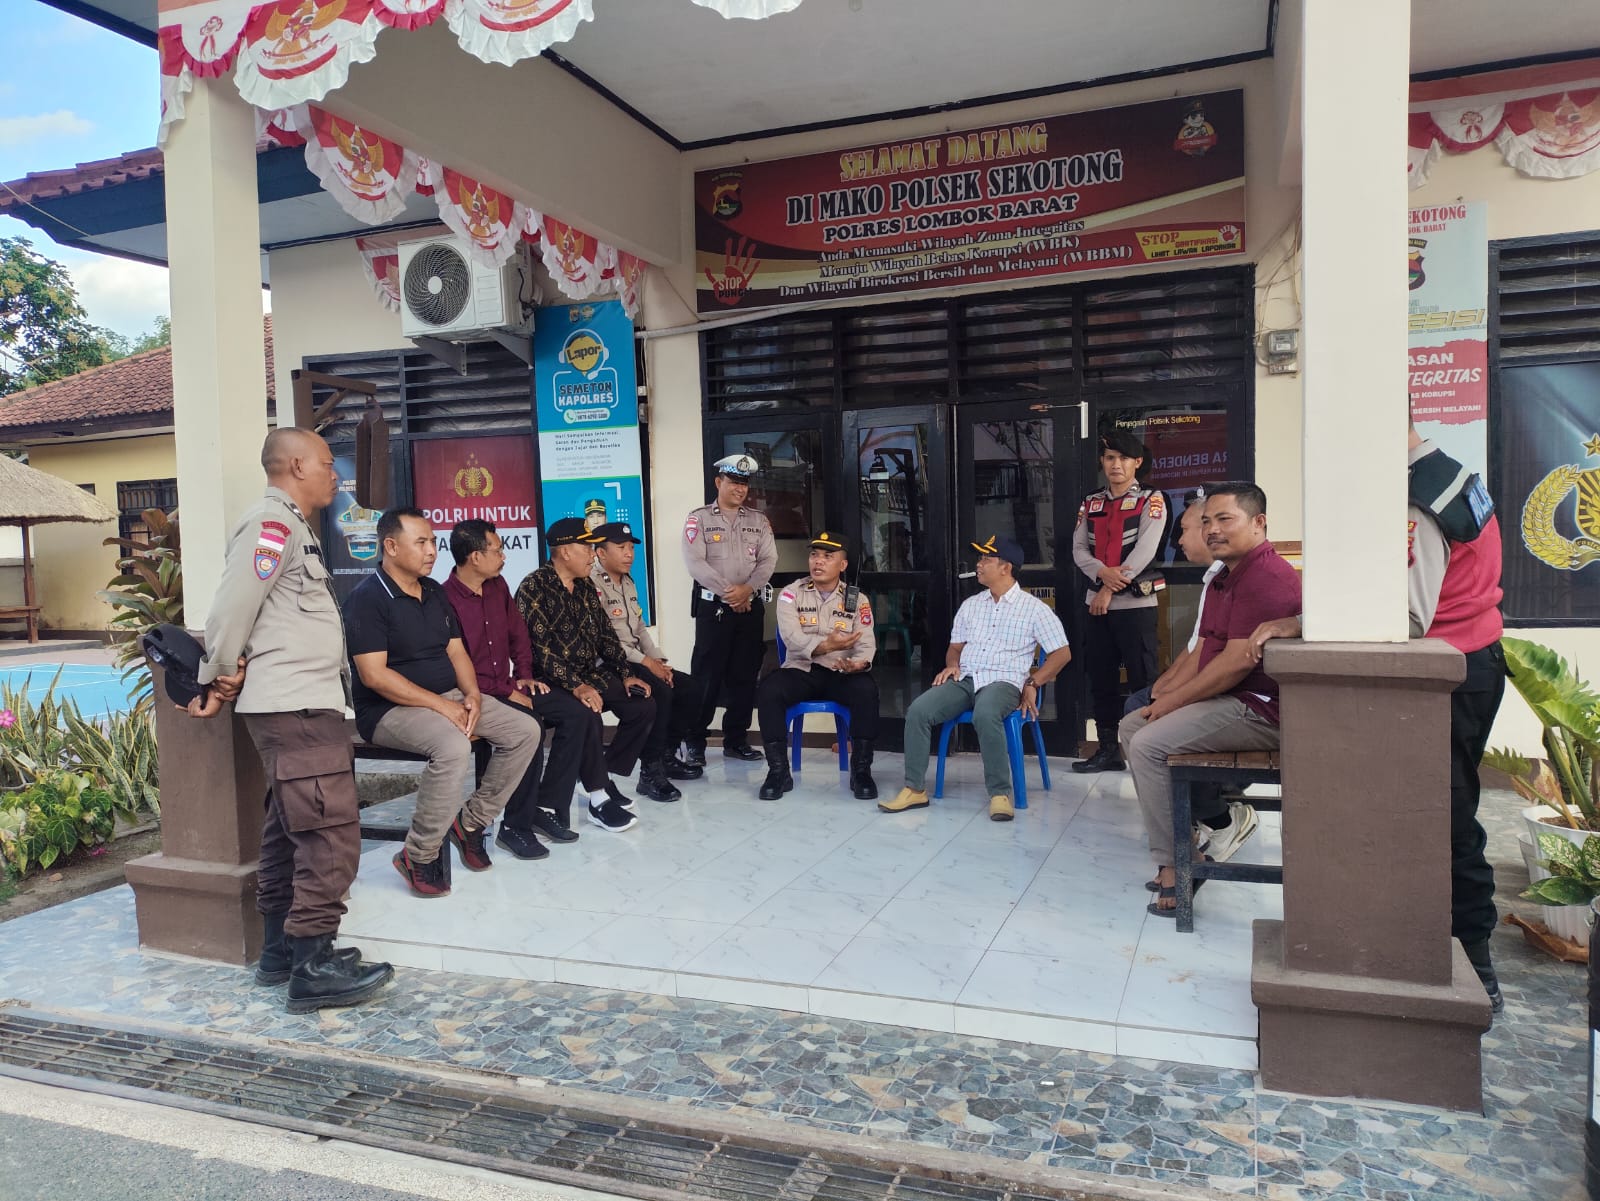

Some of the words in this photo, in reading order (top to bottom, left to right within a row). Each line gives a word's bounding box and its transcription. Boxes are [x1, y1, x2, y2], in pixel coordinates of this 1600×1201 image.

[840, 139, 941, 182] SELAMAT
[946, 122, 1048, 167] DATANG
[786, 194, 814, 226] DI
[818, 184, 885, 222] MAKO
[889, 170, 982, 213] POLSEK
[987, 149, 1123, 199] SEKOTONG
[823, 219, 901, 244] POLRES
[904, 205, 996, 233] LOMBOK
[997, 193, 1079, 221] BARAT
[1408, 205, 1466, 224] KOTONG
[819, 249, 850, 263] Anda
[852, 240, 917, 258] Memasuki
[920, 233, 973, 251] Wilayah
[976, 231, 1011, 244] Zona
[1014, 220, 1084, 239] Integritas
[1142, 231, 1180, 246] STOP
[820, 264, 868, 279] Menuju
[870, 255, 923, 272] Wilayah
[924, 252, 965, 266] Bebas
[968, 243, 1022, 259] Korupsi
[1026, 236, 1079, 254] (WBK)
[718, 276, 743, 290] STOP
[779, 286, 804, 297] Dan
[807, 278, 856, 294] Wilayah
[860, 271, 919, 287] Birokrasi
[923, 266, 966, 281] Bersih
[969, 264, 993, 275] dan
[998, 255, 1059, 273] Melayani
[566, 345, 601, 361] Lapor
[559, 382, 612, 395] SEMETON
[1422, 390, 1455, 398] KORUPSI
[558, 392, 613, 407] KAPOLRES
[1149, 417, 1170, 425] Polsek
[1171, 415, 1200, 424] Sekotong
[422, 507, 467, 524] POLRI
[473, 505, 531, 522] UNTUK
[832, 610, 854, 619] POLRI
